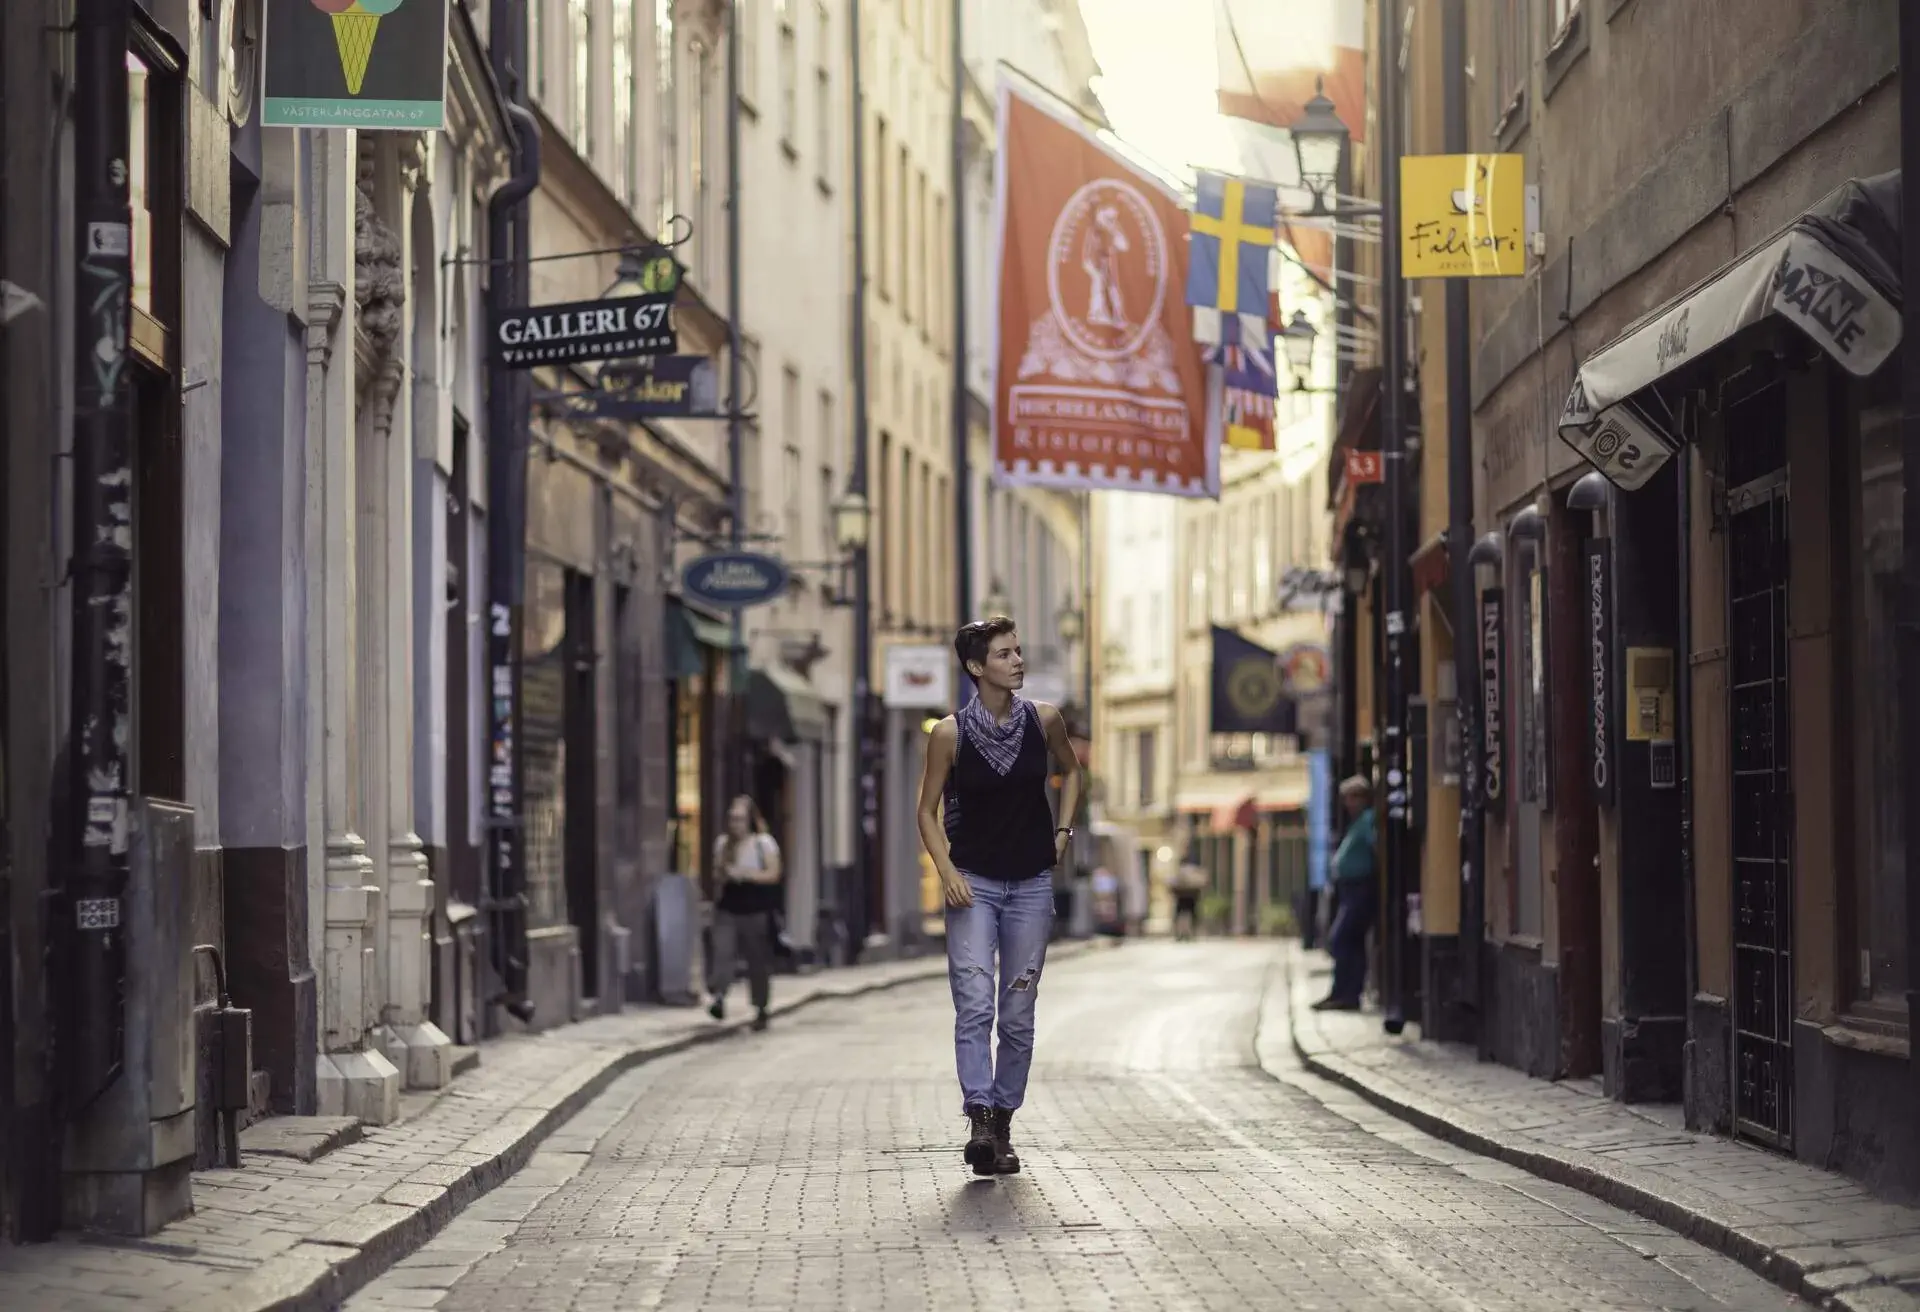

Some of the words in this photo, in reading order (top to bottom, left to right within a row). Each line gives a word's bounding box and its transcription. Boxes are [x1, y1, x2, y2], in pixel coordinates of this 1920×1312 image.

[281, 104, 405, 119] VÄSTERLÅNGGATAN
[409, 110, 425, 120] 67
[498, 307, 627, 345] GALLERI
[633, 302, 668, 331] 67
[1591, 554, 1607, 788] ESPRESSO
